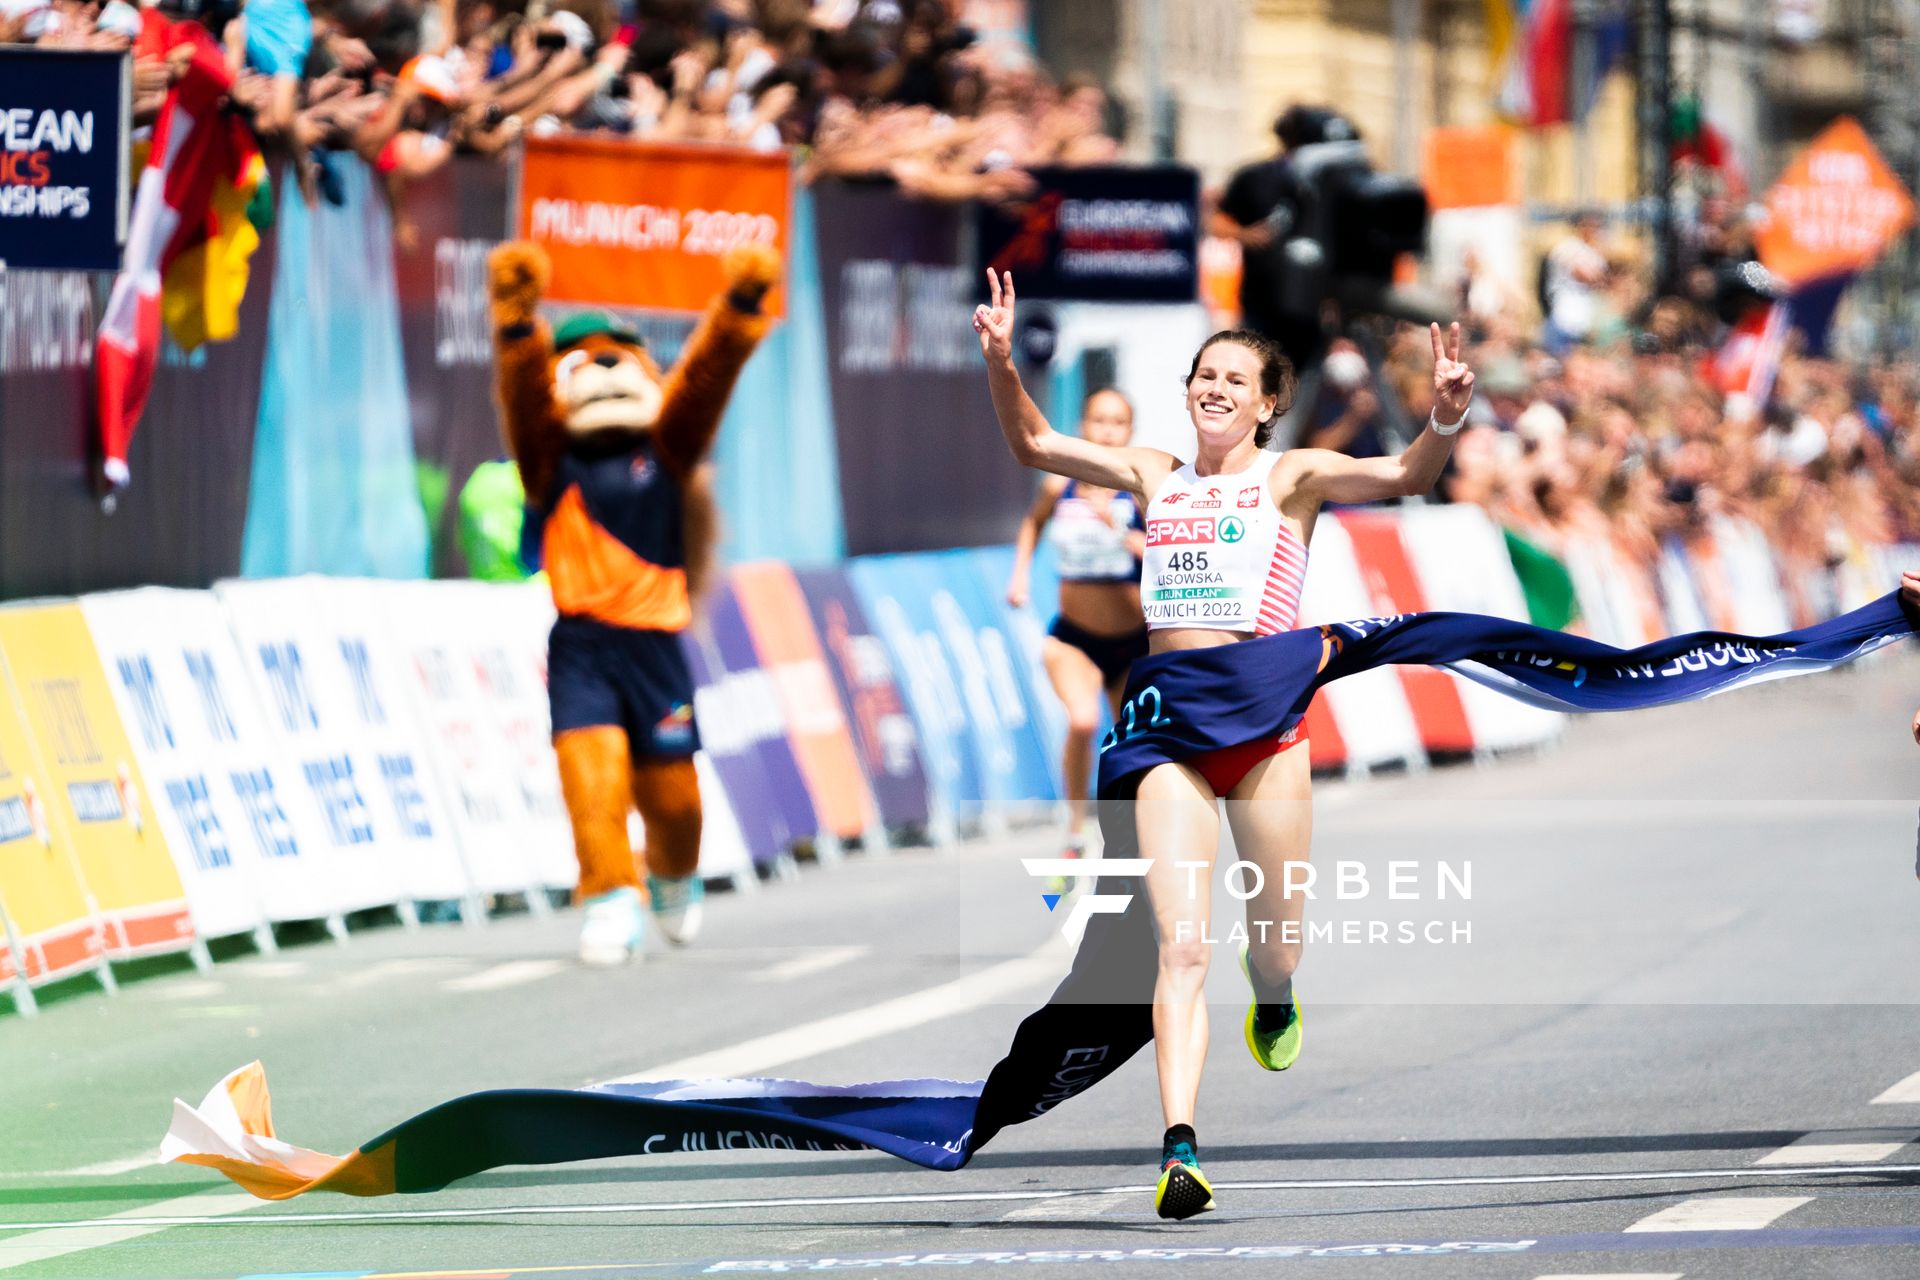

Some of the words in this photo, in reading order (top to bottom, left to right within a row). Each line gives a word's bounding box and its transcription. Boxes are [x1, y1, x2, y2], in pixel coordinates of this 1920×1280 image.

[1146, 520, 1214, 543] SPAR
[1168, 551, 1208, 571] 485
[1158, 572, 1223, 586] LISOWSKA
[1165, 589, 1182, 599] RUN
[1144, 603, 1196, 617] MUNICH
[1202, 602, 1242, 617] 2022
